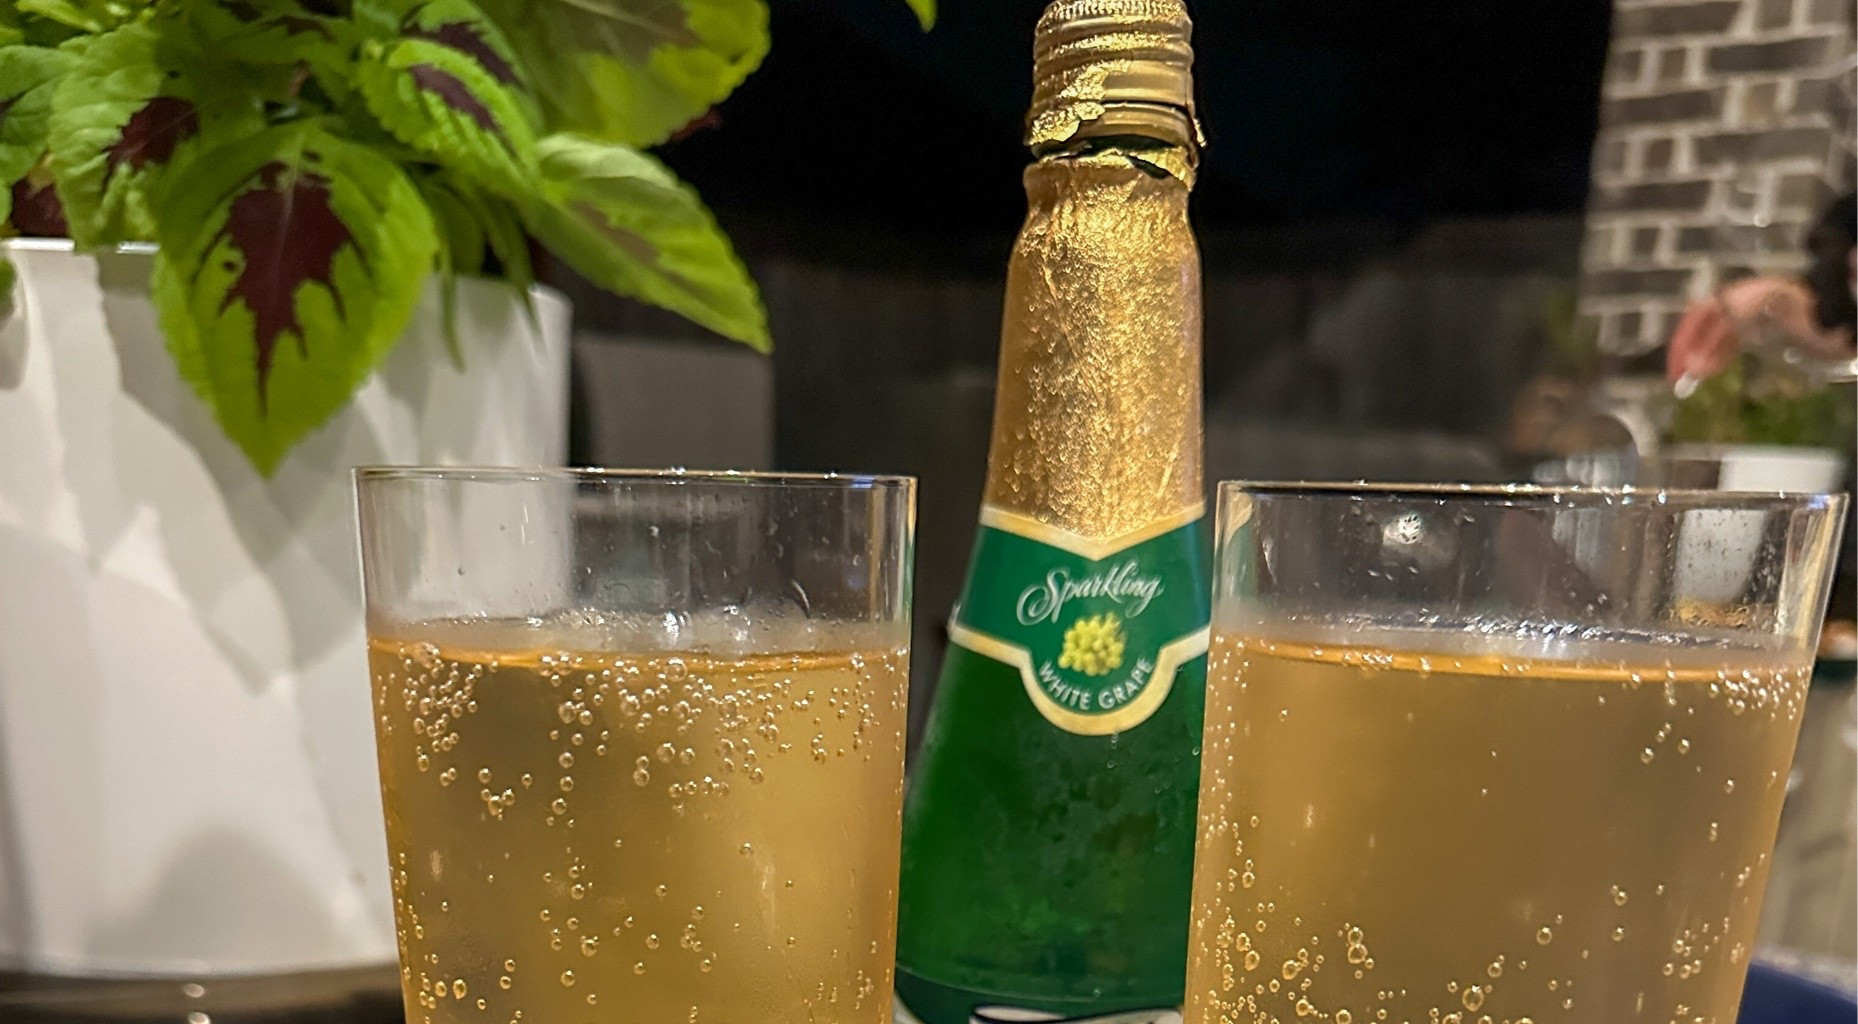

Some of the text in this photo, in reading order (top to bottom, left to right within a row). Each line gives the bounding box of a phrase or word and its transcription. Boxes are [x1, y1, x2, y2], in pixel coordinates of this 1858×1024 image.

[1016, 560, 1164, 626] Sparkling
[1038, 656, 1155, 710] WHITE GRAPE
